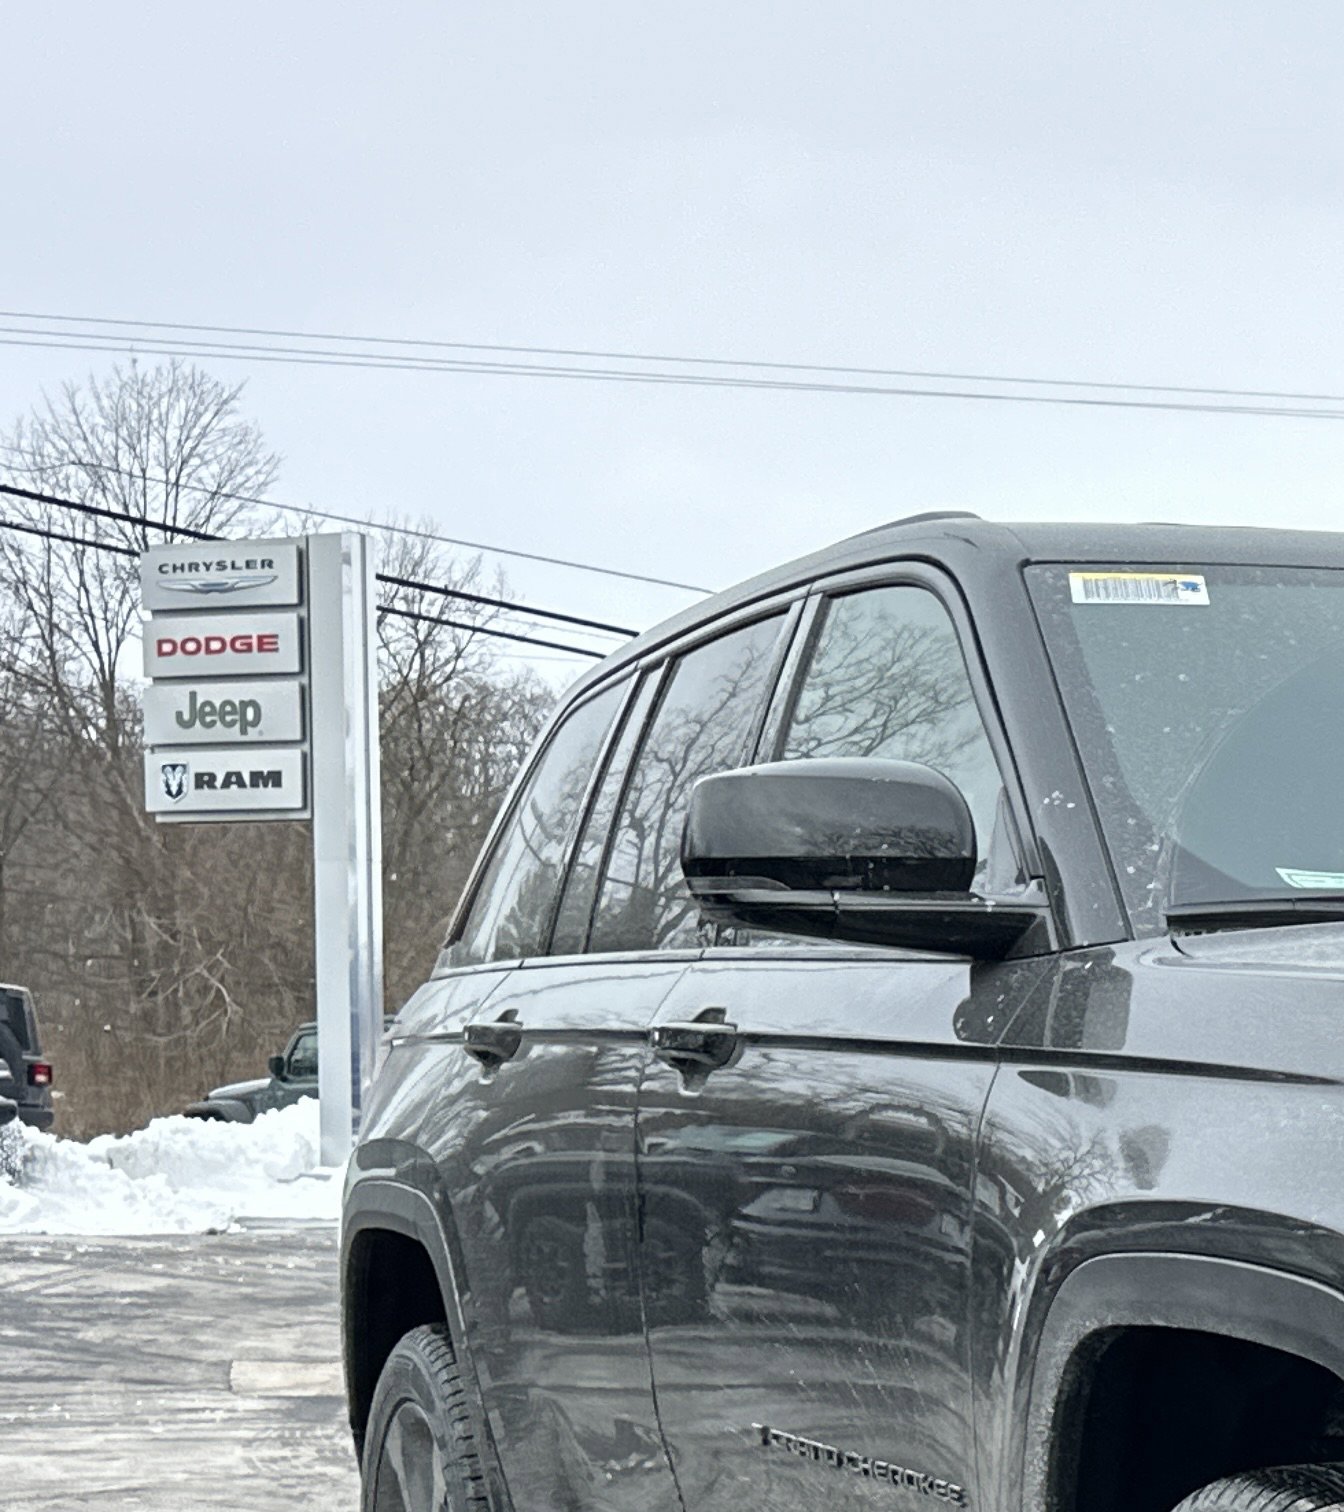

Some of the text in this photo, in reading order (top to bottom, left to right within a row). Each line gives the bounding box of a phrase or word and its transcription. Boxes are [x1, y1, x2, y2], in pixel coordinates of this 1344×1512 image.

[157, 558, 275, 575] CHRYSLER
[156, 633, 280, 658] DODGE
[175, 690, 263, 736] Jeep
[194, 769, 283, 790] RAM
[846, 1451, 968, 1508] CHEROKEE
